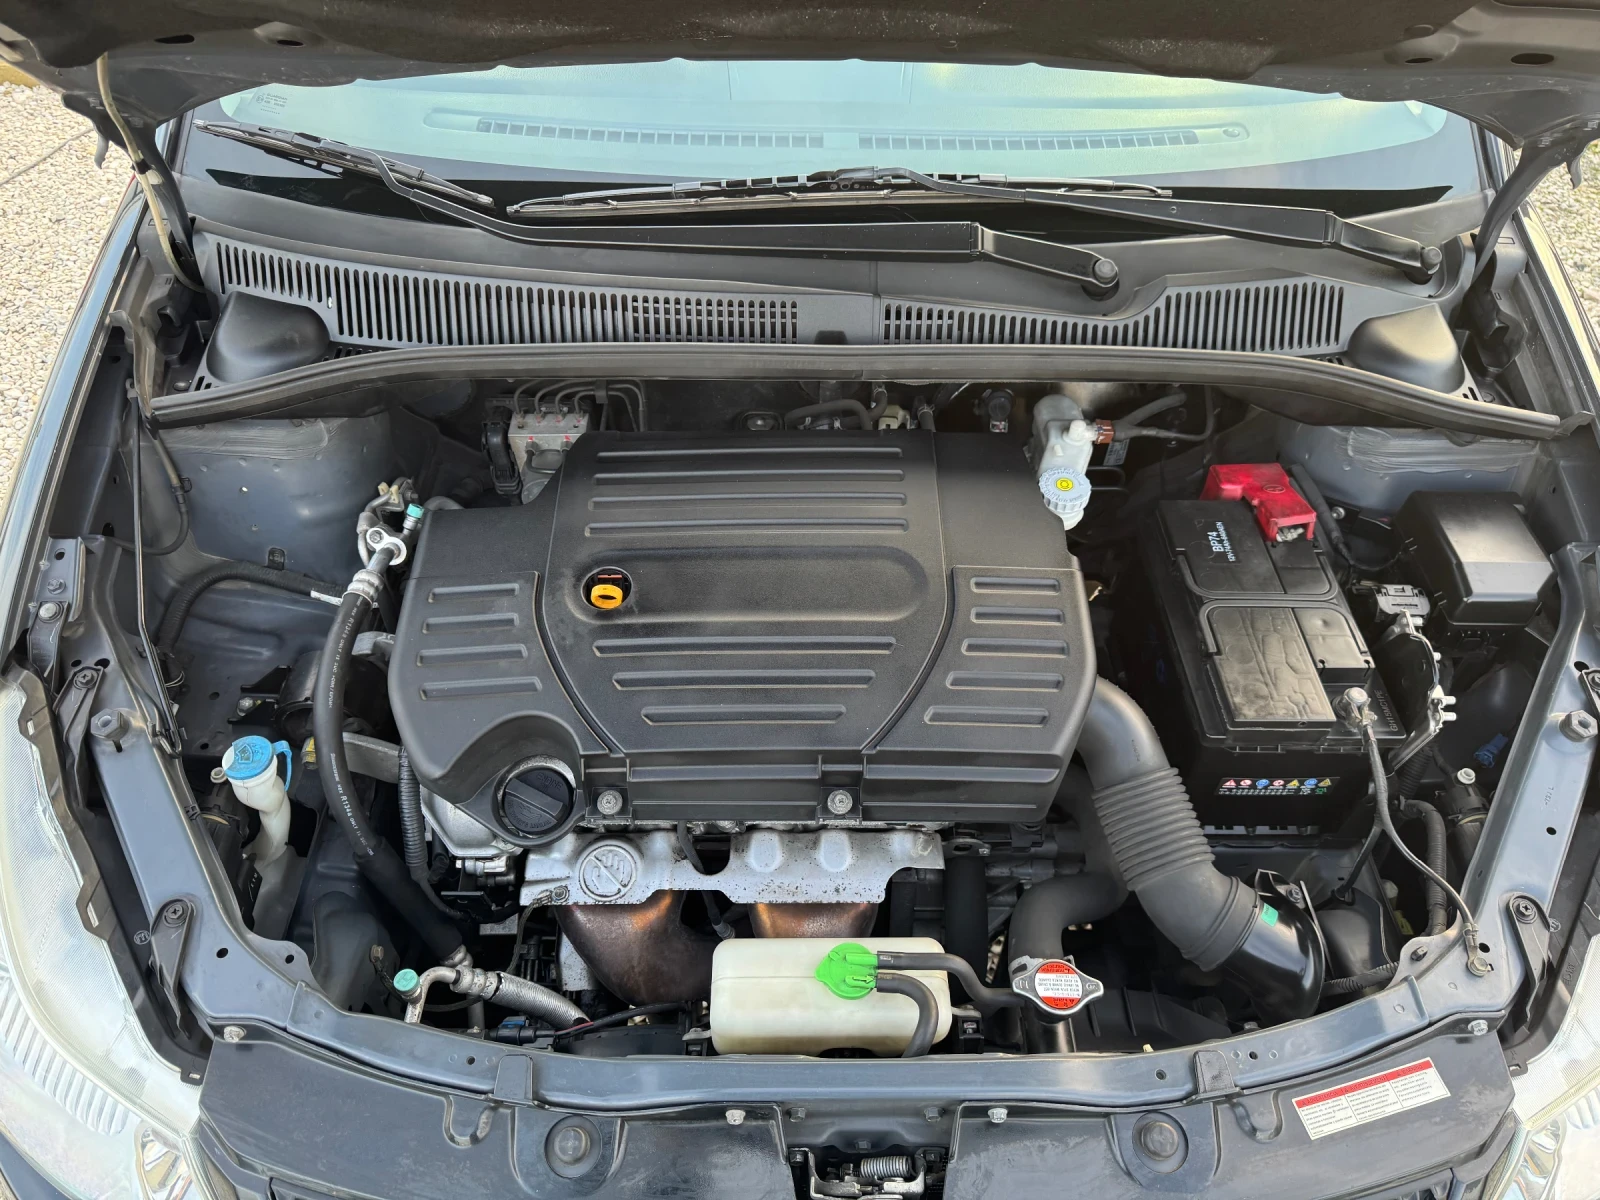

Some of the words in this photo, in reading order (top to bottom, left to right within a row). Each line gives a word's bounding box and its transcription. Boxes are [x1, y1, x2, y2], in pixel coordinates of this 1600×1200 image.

[1207, 531, 1224, 552] BP74
[343, 618, 354, 638] R134a
[341, 795, 352, 817] R134a
